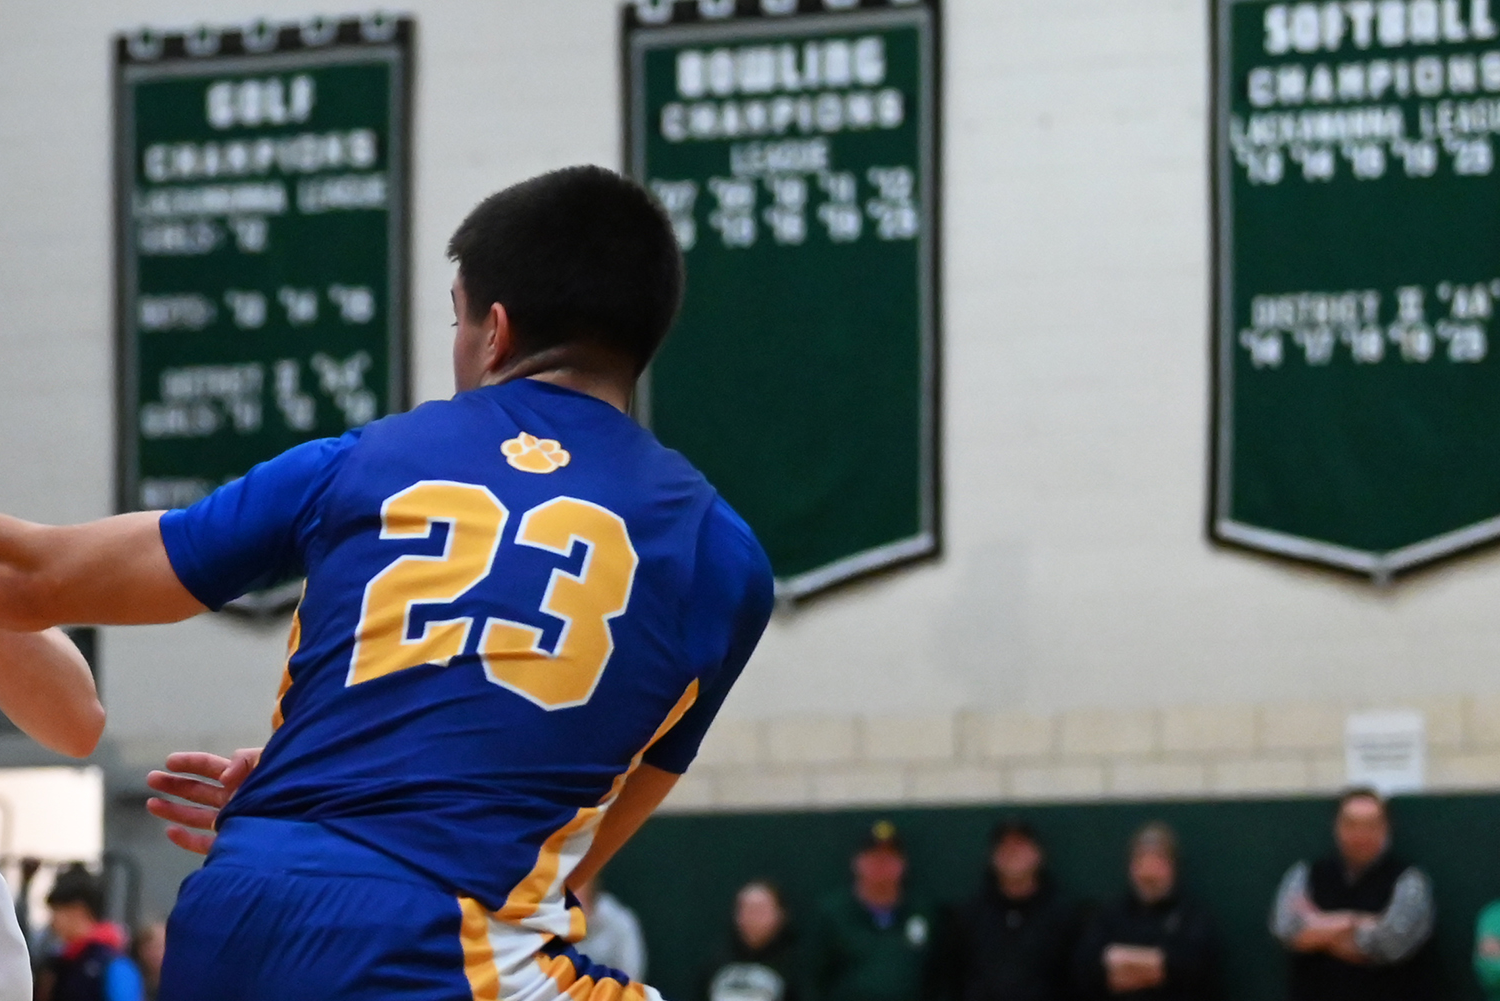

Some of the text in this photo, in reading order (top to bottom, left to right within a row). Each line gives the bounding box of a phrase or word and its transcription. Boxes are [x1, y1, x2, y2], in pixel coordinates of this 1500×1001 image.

[1263, 0, 1499, 54] SOFTBALL
[676, 36, 885, 98] BOWLING
[1248, 52, 1500, 106] CHAMPIONS
[206, 76, 315, 128] GOLF
[660, 88, 903, 143] CHAMPIONS
[144, 129, 377, 181] CHAMPIONS
[345, 480, 639, 711] 23
